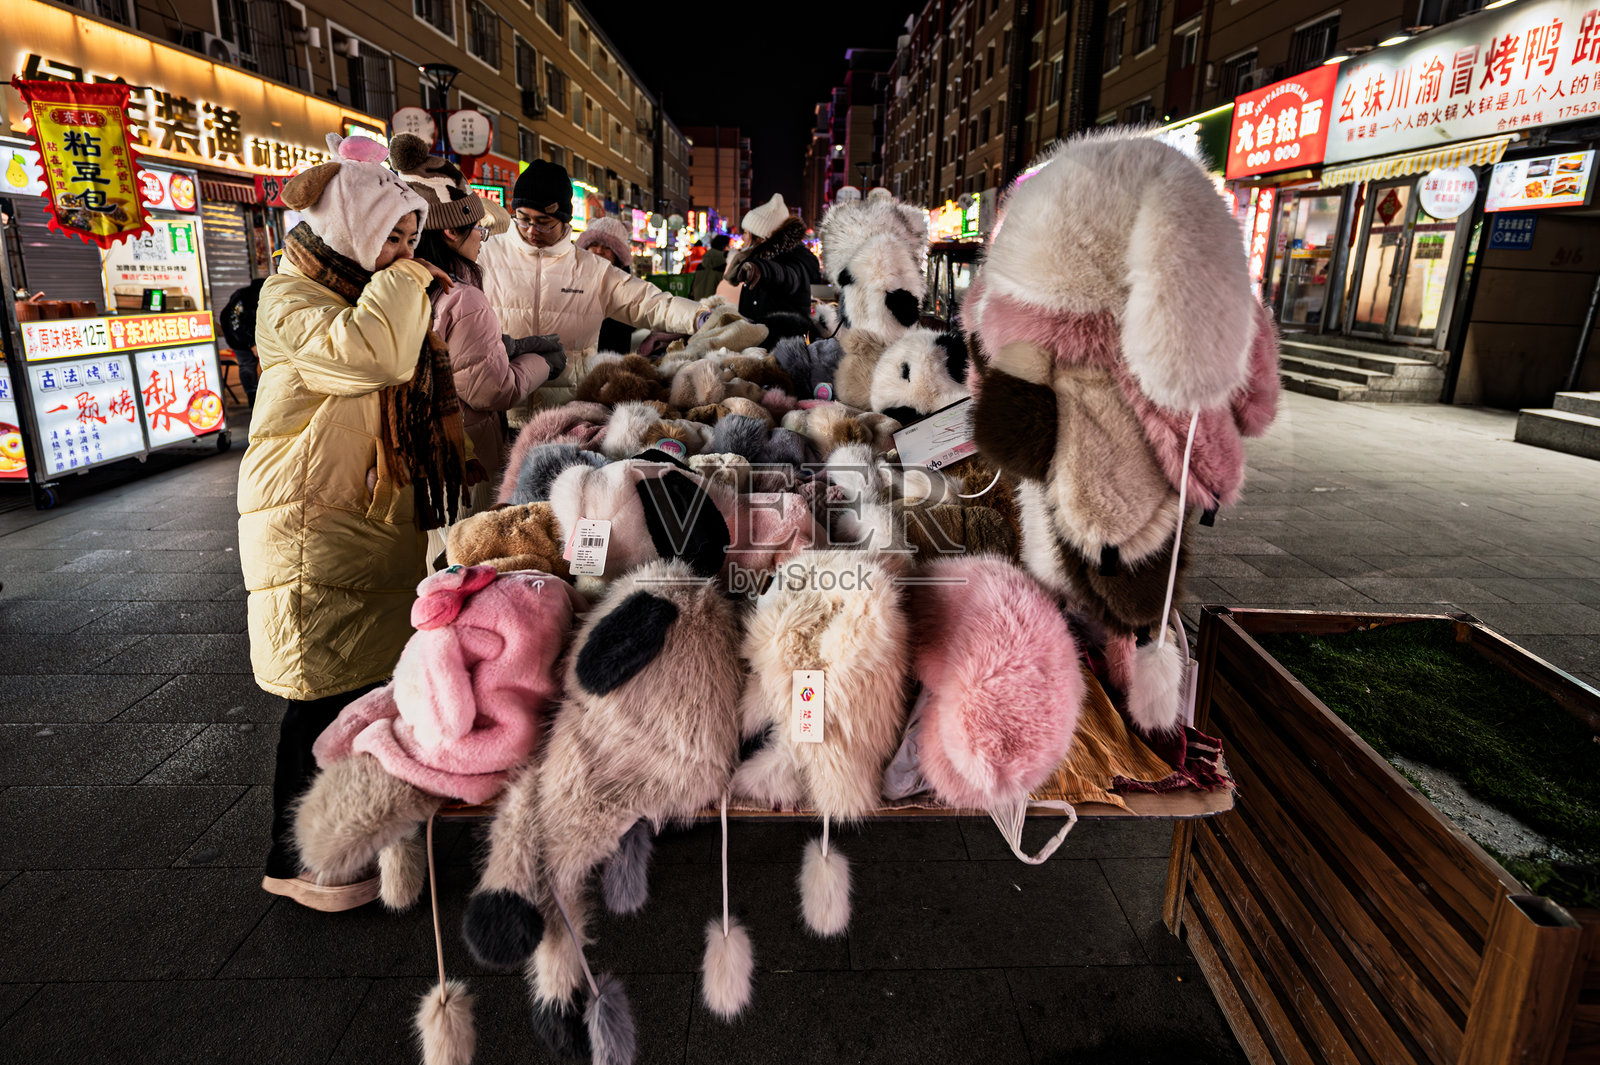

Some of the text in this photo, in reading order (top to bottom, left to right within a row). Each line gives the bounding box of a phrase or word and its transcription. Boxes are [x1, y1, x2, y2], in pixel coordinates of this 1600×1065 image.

[63, 111, 97, 126] 东北
[1558, 101, 1600, 119] 17543
[1235, 98, 1324, 154] 九台热面
[63, 130, 118, 213] 粘豆包
[83, 324, 107, 347] 12元
[125, 317, 190, 345] 东北粘豆包
[41, 361, 121, 389] 古法烤梨
